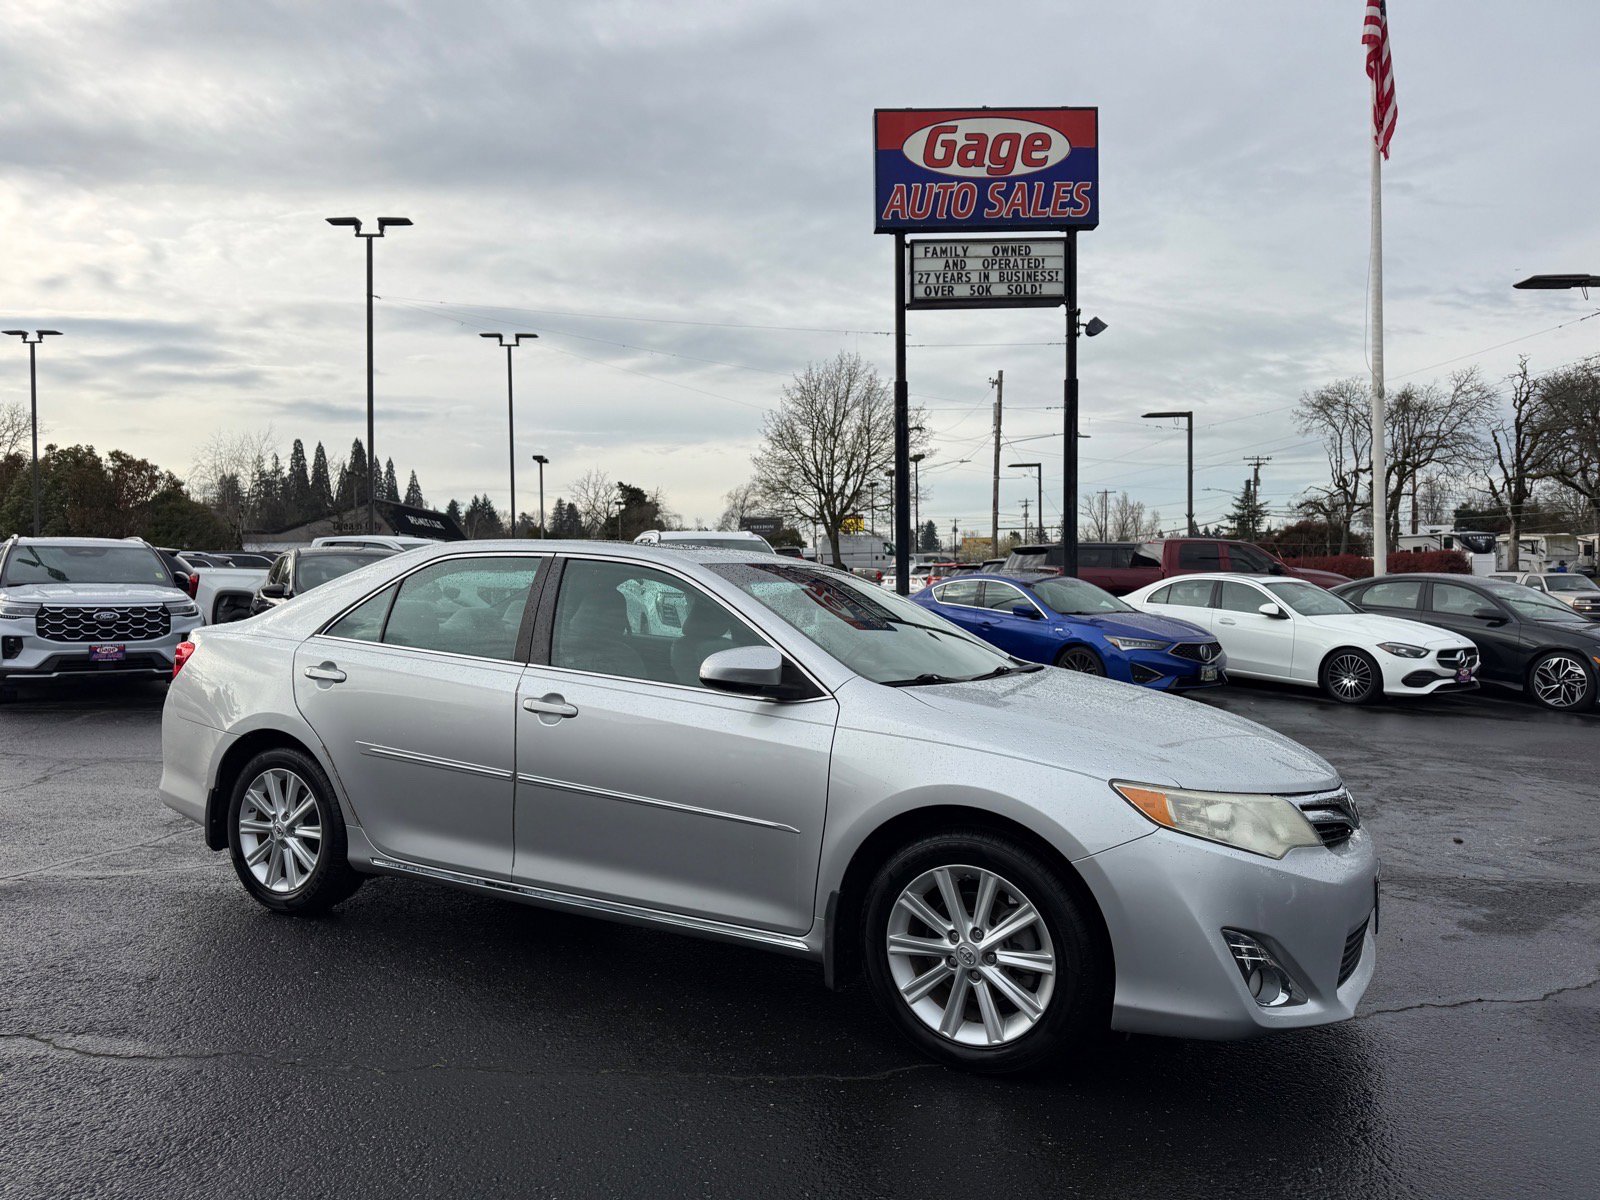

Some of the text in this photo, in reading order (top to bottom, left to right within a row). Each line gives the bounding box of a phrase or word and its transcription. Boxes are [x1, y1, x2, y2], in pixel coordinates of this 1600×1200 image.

[923, 125, 1052, 176] Gage
[882, 181, 1091, 219] AUTO SALES
[924, 245, 1031, 257] FAMILY OWNED
[944, 258, 1045, 270] AND OPERATED!
[918, 271, 1059, 283] 27 YEARS IN BUSINESS!
[924, 284, 1043, 296] OVER 50K SOLD!
